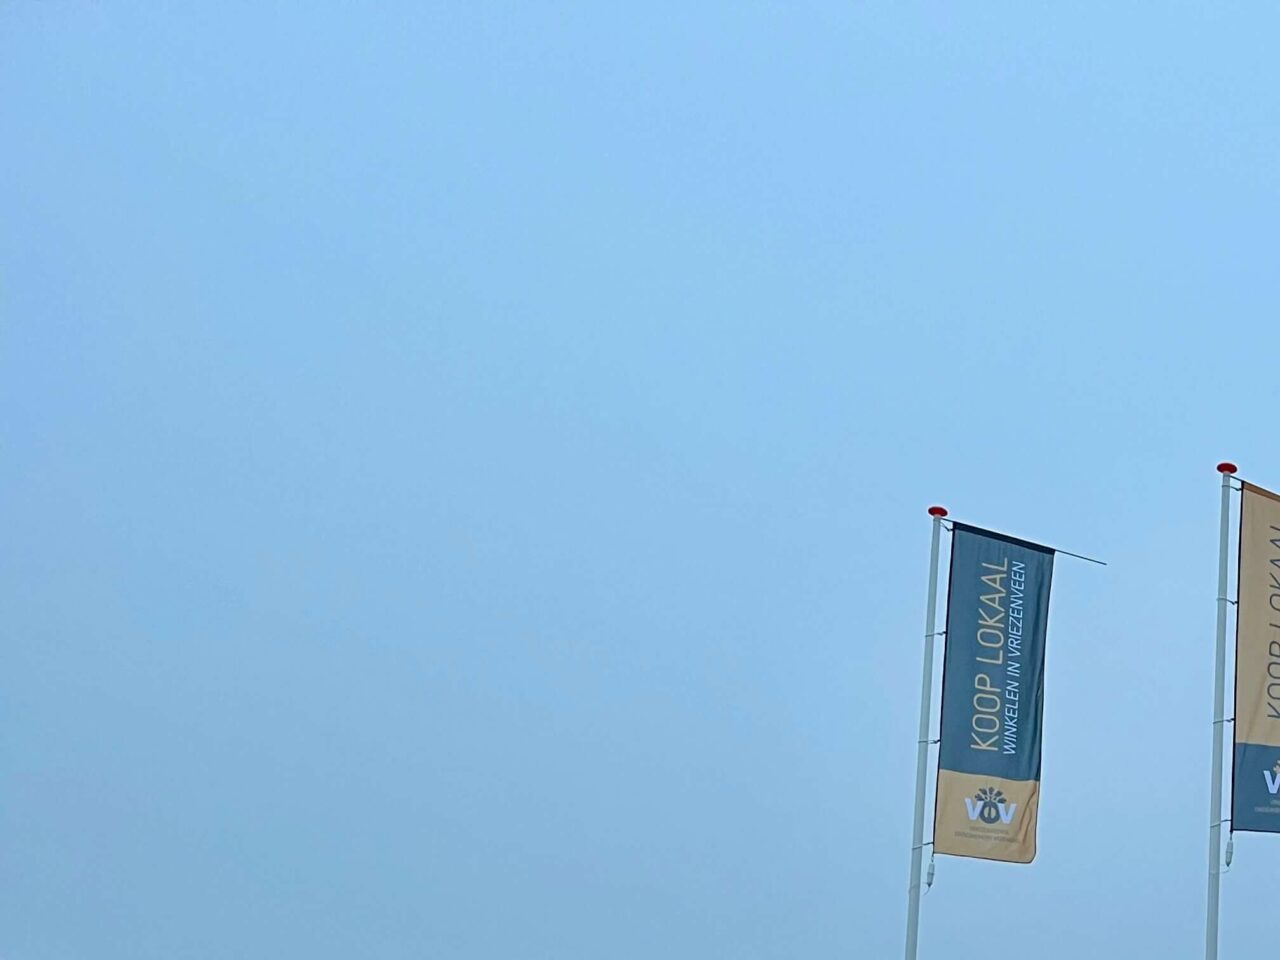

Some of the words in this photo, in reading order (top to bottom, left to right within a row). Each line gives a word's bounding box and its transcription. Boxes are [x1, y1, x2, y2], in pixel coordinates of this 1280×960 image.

[976, 556, 1009, 664] LOKAAL
[1008, 561, 1026, 661] VRIEZENVEEN
[970, 673, 1001, 752] KOOP
[1006, 661, 1021, 685] IN
[1002, 686, 1019, 755] WINKELEN
